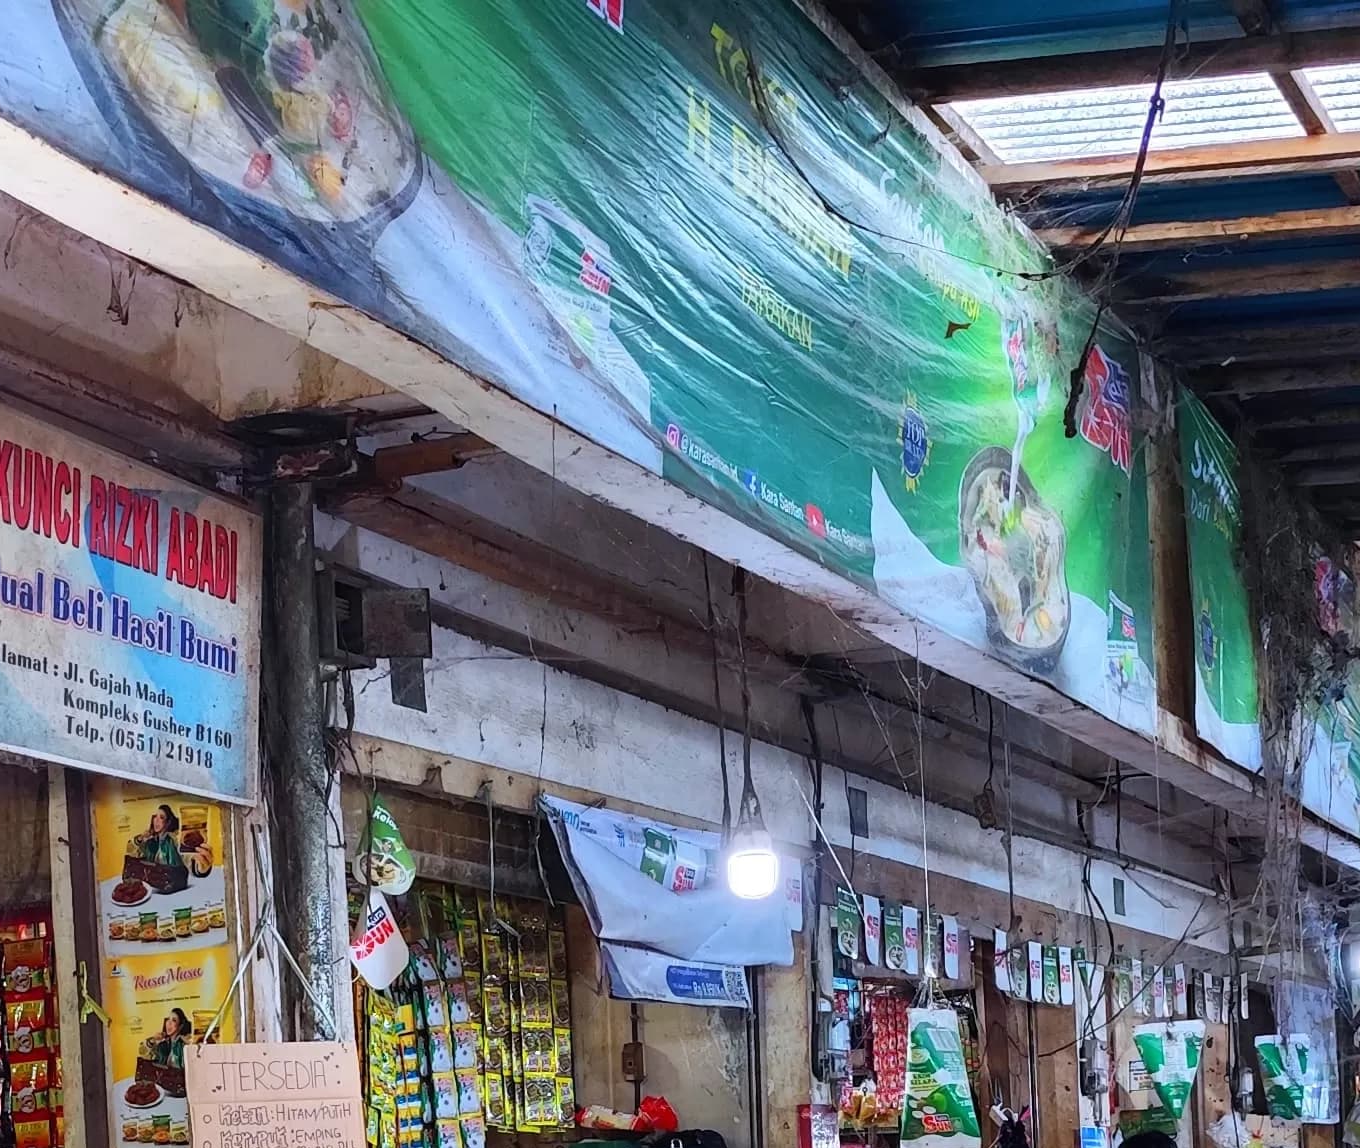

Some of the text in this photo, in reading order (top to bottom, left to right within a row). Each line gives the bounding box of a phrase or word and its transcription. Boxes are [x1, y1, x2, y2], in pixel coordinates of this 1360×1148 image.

[761, 482, 779, 507] Kara
[90, 475, 159, 576] RIZKI
[166, 507, 238, 604] ABADI
[53, 576, 104, 633] Beli
[111, 597, 172, 655] Hasil
[180, 618, 238, 674] Bumi
[63, 662, 84, 684] Jl.
[90, 669, 131, 696] Gajah
[135, 681, 174, 708] Mada
[63, 688, 232, 749] Kompleks Gusher B160
[65, 715, 213, 769] Telp. (0551) 21918
[209, 1060, 327, 1092] TERSEDIA
[295, 1128, 342, 1144] EMPING
